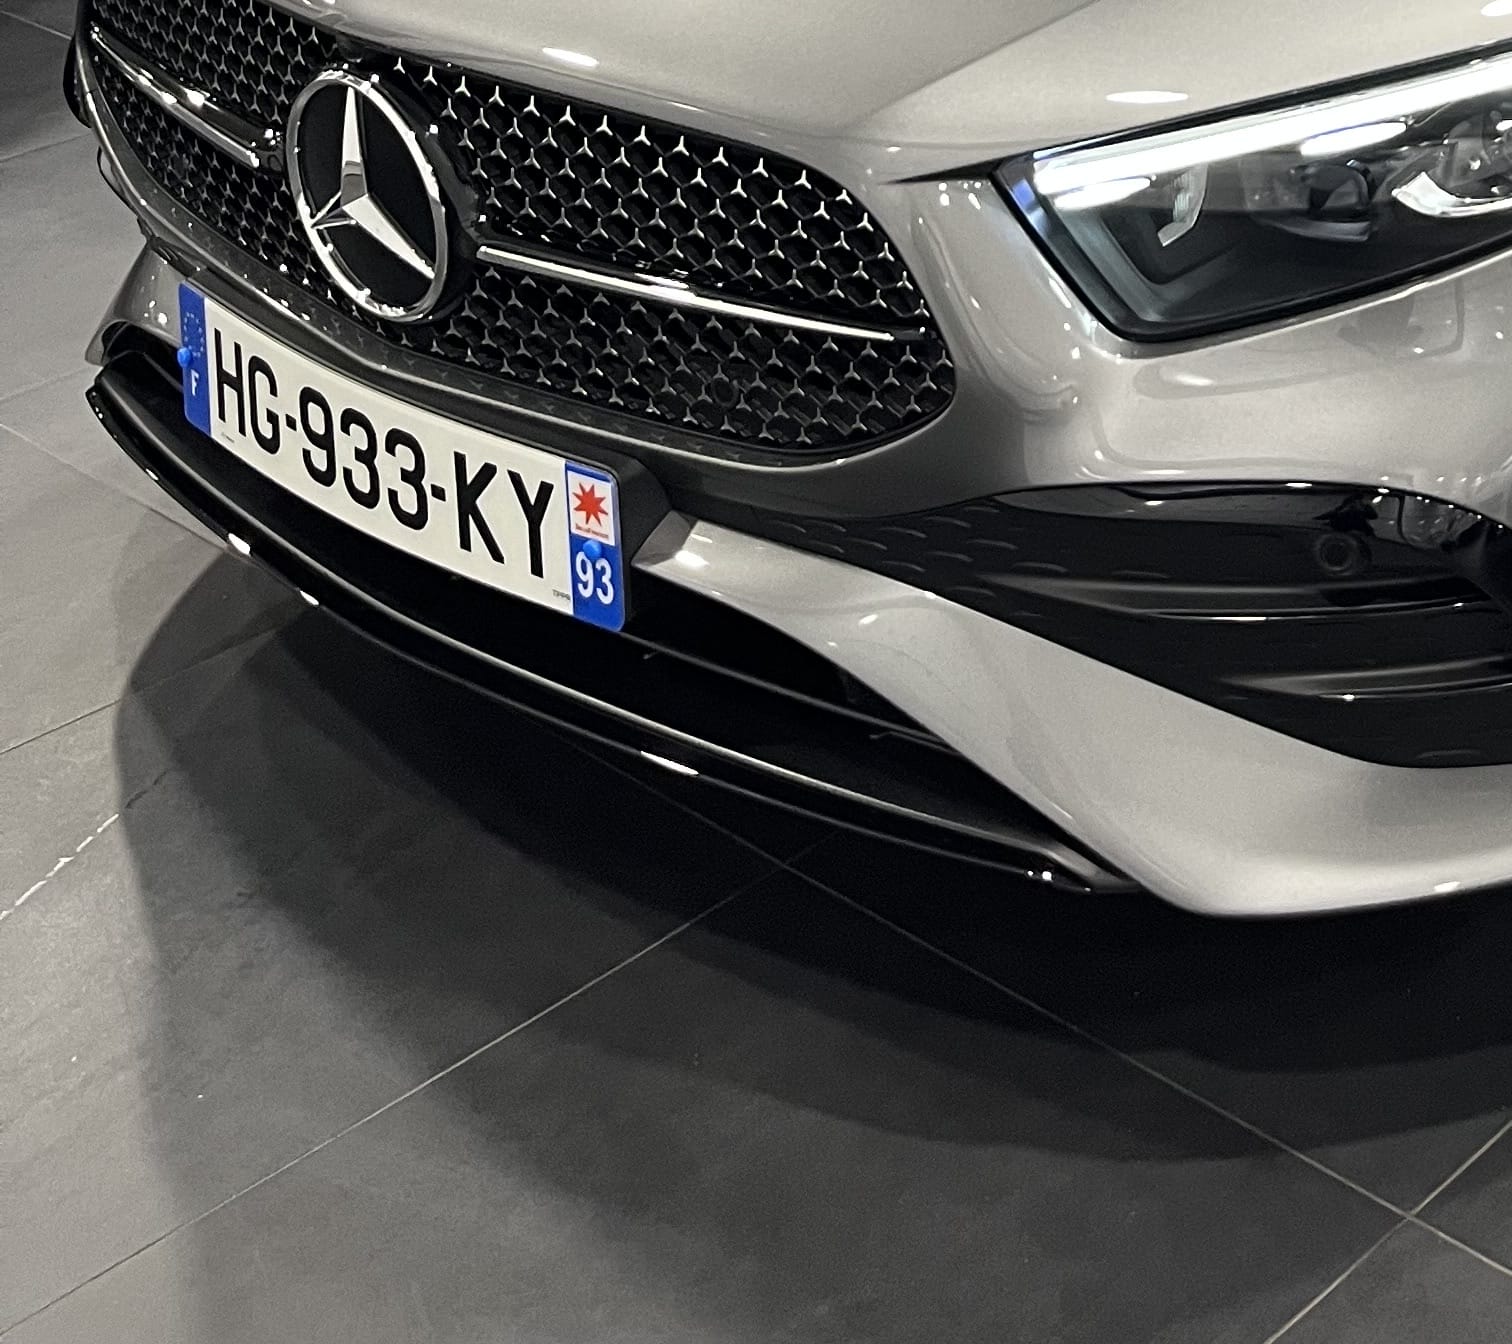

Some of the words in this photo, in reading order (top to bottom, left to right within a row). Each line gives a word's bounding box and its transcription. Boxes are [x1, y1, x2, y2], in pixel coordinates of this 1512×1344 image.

[190, 368, 200, 397] F
[213, 326, 555, 580] HG-933-KY
[575, 551, 615, 605] 93
